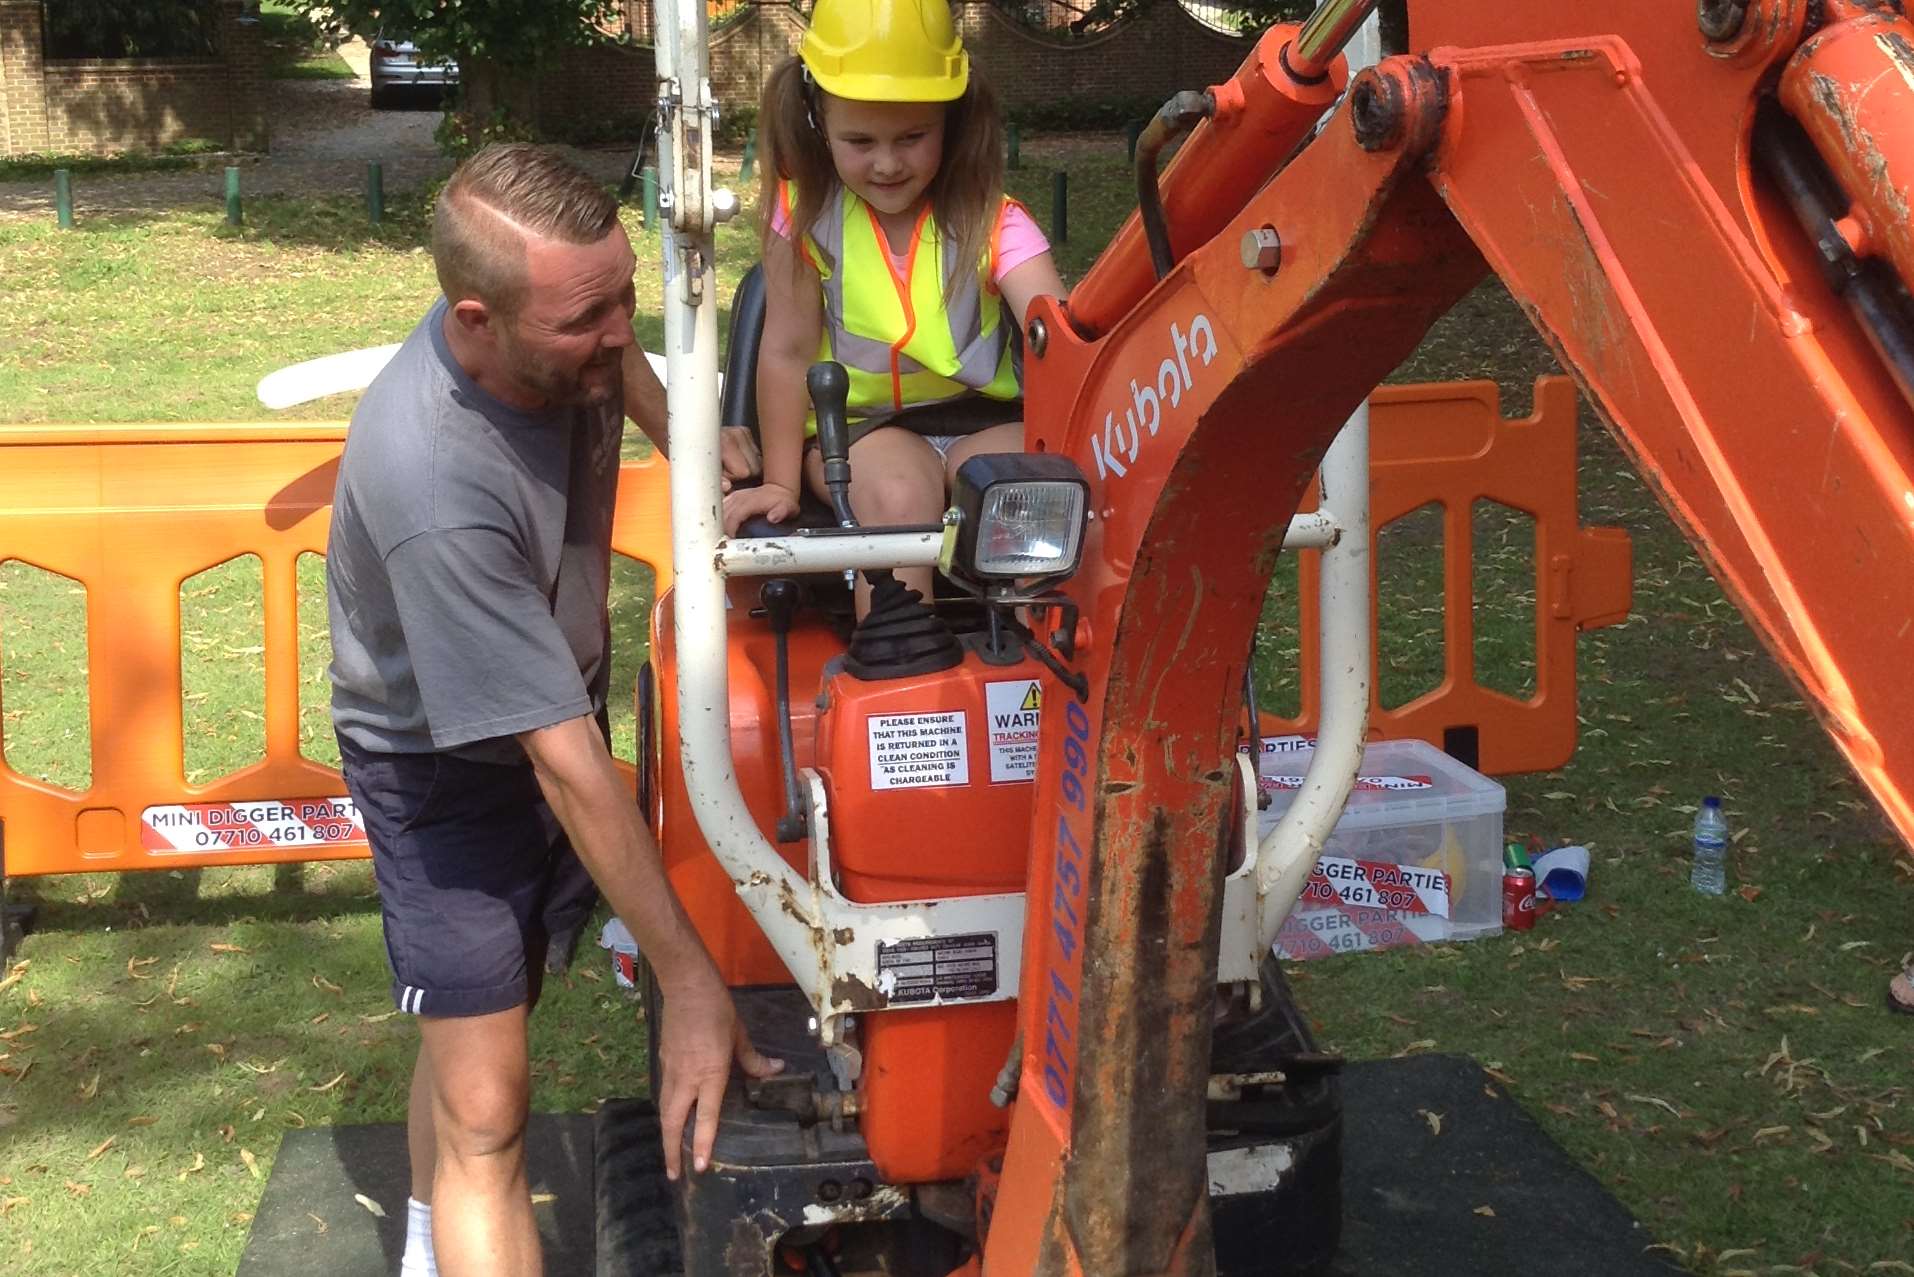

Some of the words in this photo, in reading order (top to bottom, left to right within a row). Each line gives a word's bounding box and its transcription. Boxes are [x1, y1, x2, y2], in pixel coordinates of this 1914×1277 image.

[1091, 315, 1217, 480] Kubota
[880, 718, 915, 726] PLEASE
[918, 715, 954, 724] ENSURE
[873, 731, 895, 739] THAT
[897, 729, 918, 737] THIS
[920, 727, 962, 735] MACHINE
[889, 740, 936, 749] RETURNED
[878, 754, 907, 762] CLEAN
[910, 750, 960, 760] CONDITION
[1062, 701, 1088, 812] 990
[898, 763, 944, 772] CLEANING
[890, 774, 951, 785] CHARGEABLE
[153, 811, 200, 827] MINI
[210, 807, 294, 824] DIGGER
[196, 828, 261, 845] 07710
[269, 826, 305, 841] 461
[313, 823, 353, 840] 807
[1054, 815, 1083, 961] 4757
[1339, 886, 1372, 903] 461
[1378, 890, 1414, 906] 807
[1329, 931, 1361, 949] 461
